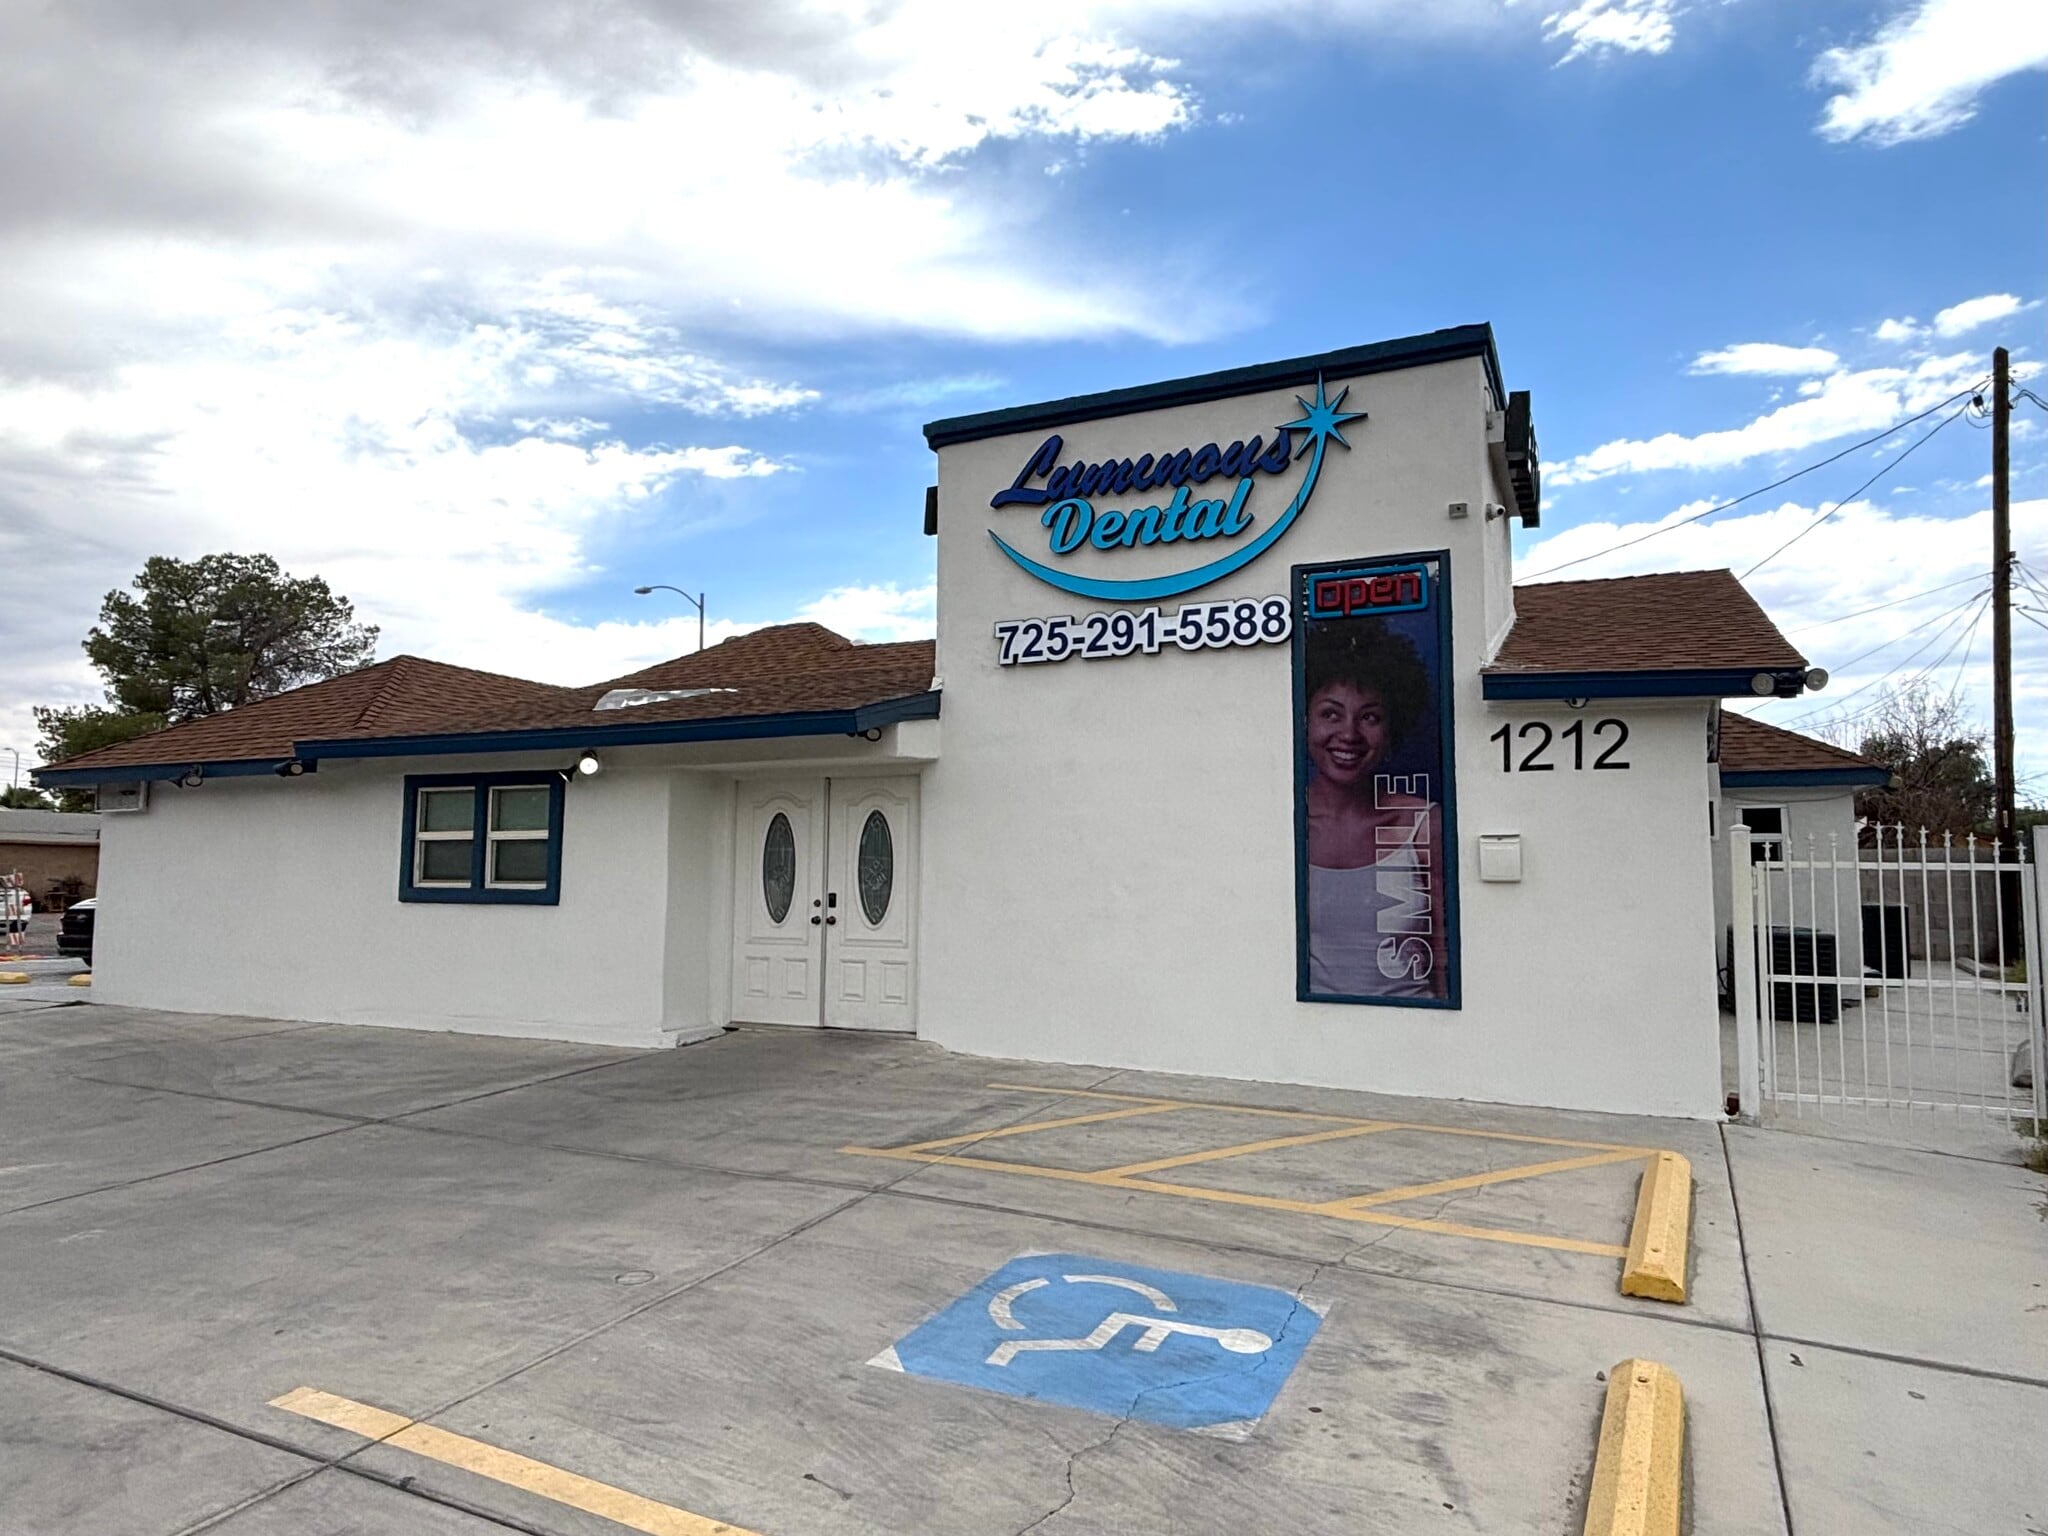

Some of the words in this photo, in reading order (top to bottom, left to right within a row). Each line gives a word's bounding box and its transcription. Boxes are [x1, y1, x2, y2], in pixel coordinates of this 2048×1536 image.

[991, 430, 1292, 508] Luminous
[1041, 477, 1253, 554] Dental
[1316, 573, 1420, 615] open
[998, 598, 1288, 664] 725-291-5588
[1490, 718, 1630, 772] 1212
[1374, 773, 1433, 980] SMILE
